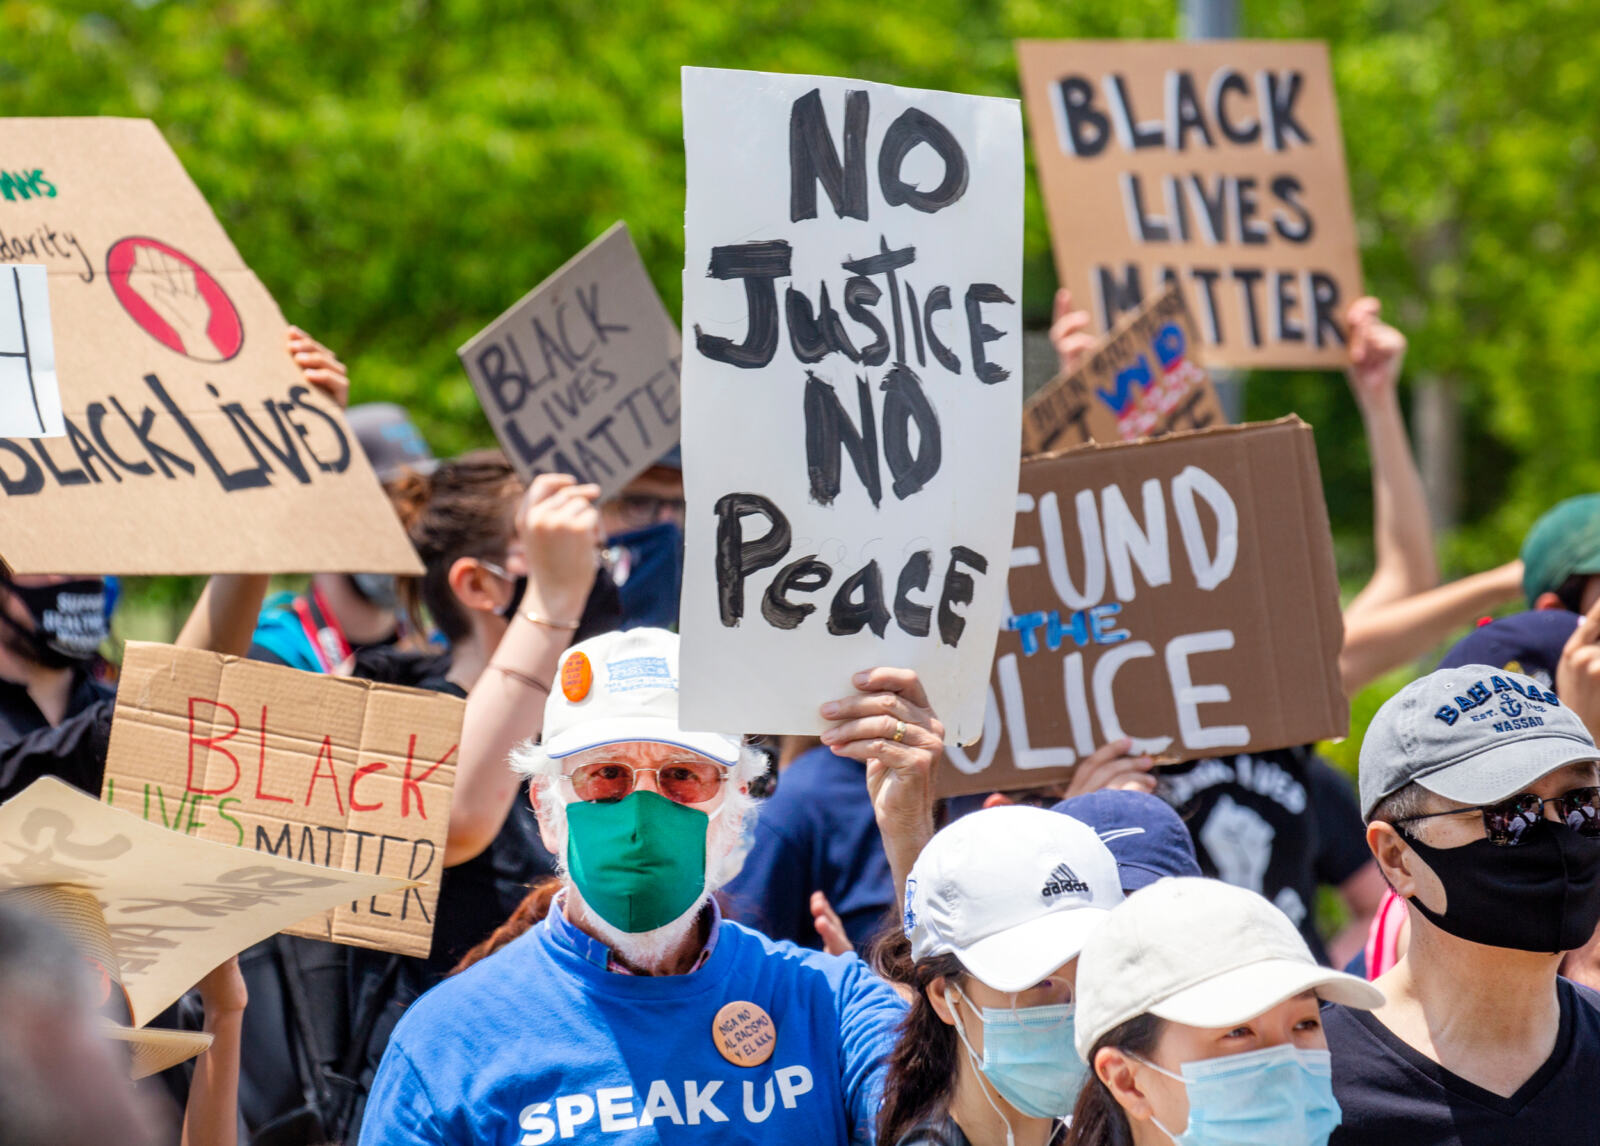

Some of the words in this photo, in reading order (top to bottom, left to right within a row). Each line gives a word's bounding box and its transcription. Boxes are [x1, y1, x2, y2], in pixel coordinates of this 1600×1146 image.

[1048, 68, 1313, 158] BLACK
[789, 87, 970, 223] NO
[1118, 171, 1314, 245] LIVES
[476, 281, 631, 416] BLACK
[502, 356, 619, 466] LIVES
[531, 356, 682, 485] ATTE
[803, 361, 942, 511] NO
[1007, 602, 1132, 656] THE
[186, 696, 459, 821] BLACK
[1492, 716, 1545, 733] NASSAU
[1042, 880, 1089, 898] adidas
[724, 1038, 737, 1051] AL
[737, 1008, 752, 1024] NO
[742, 1043, 757, 1056] EL
[519, 1079, 730, 1146] SPEAK
[742, 1064, 814, 1124] UP
